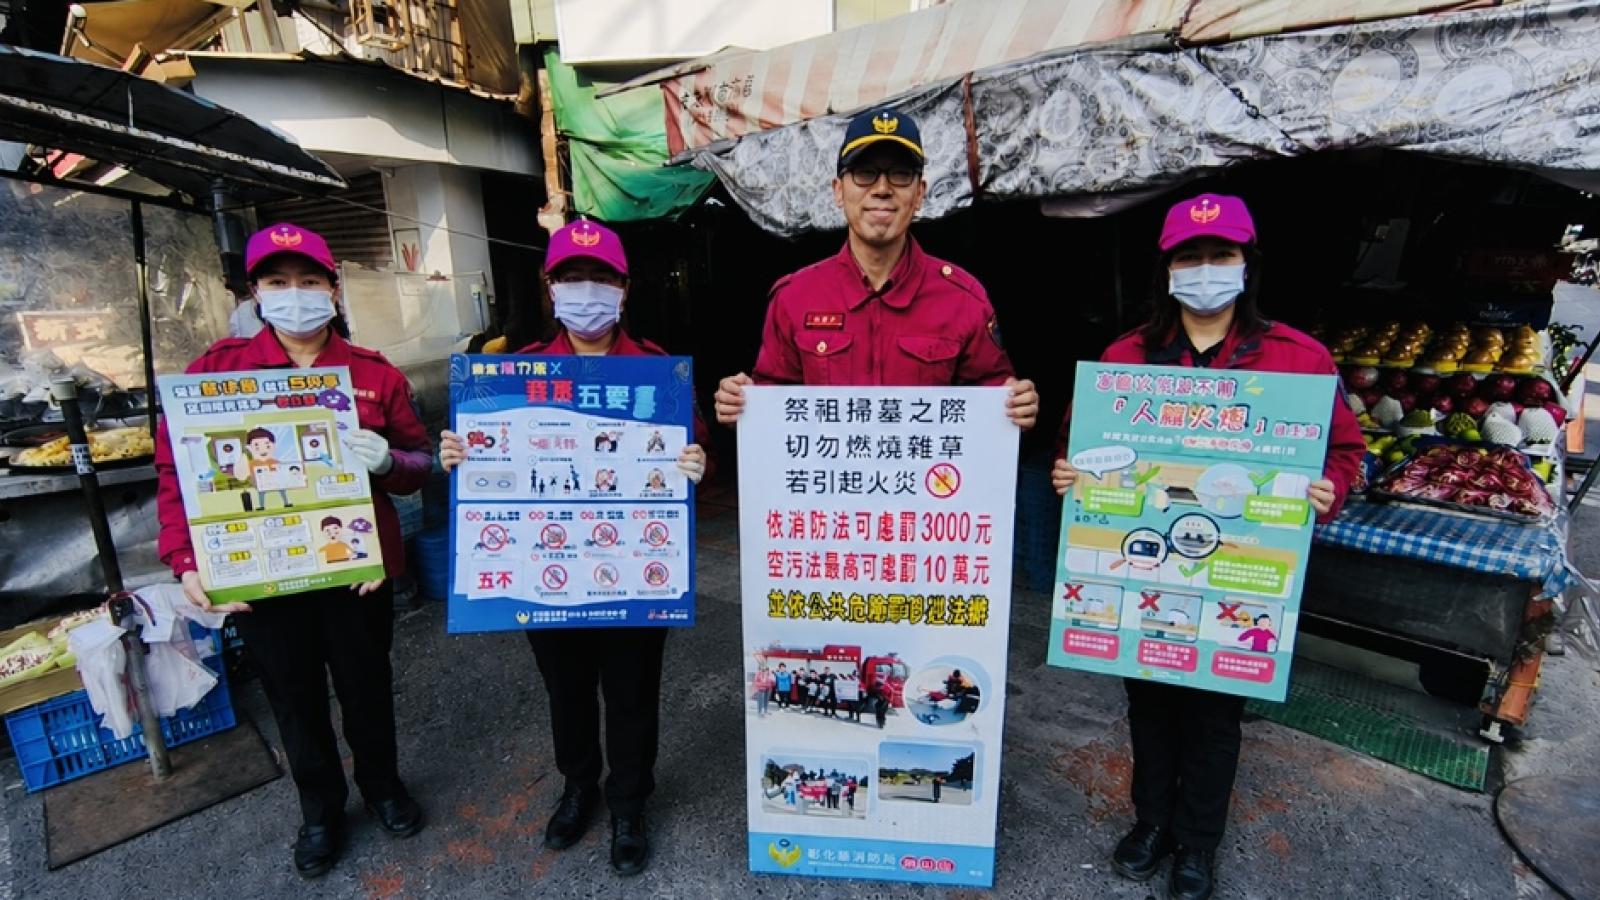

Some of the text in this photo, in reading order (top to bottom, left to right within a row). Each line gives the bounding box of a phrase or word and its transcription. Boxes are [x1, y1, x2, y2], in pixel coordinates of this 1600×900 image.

[784, 397, 967, 424] 祭祖掃墓之際
[785, 434, 964, 460] 切勿燃燒雜草
[785, 469, 918, 495] 若引起火災
[477, 571, 513, 590] 五不
